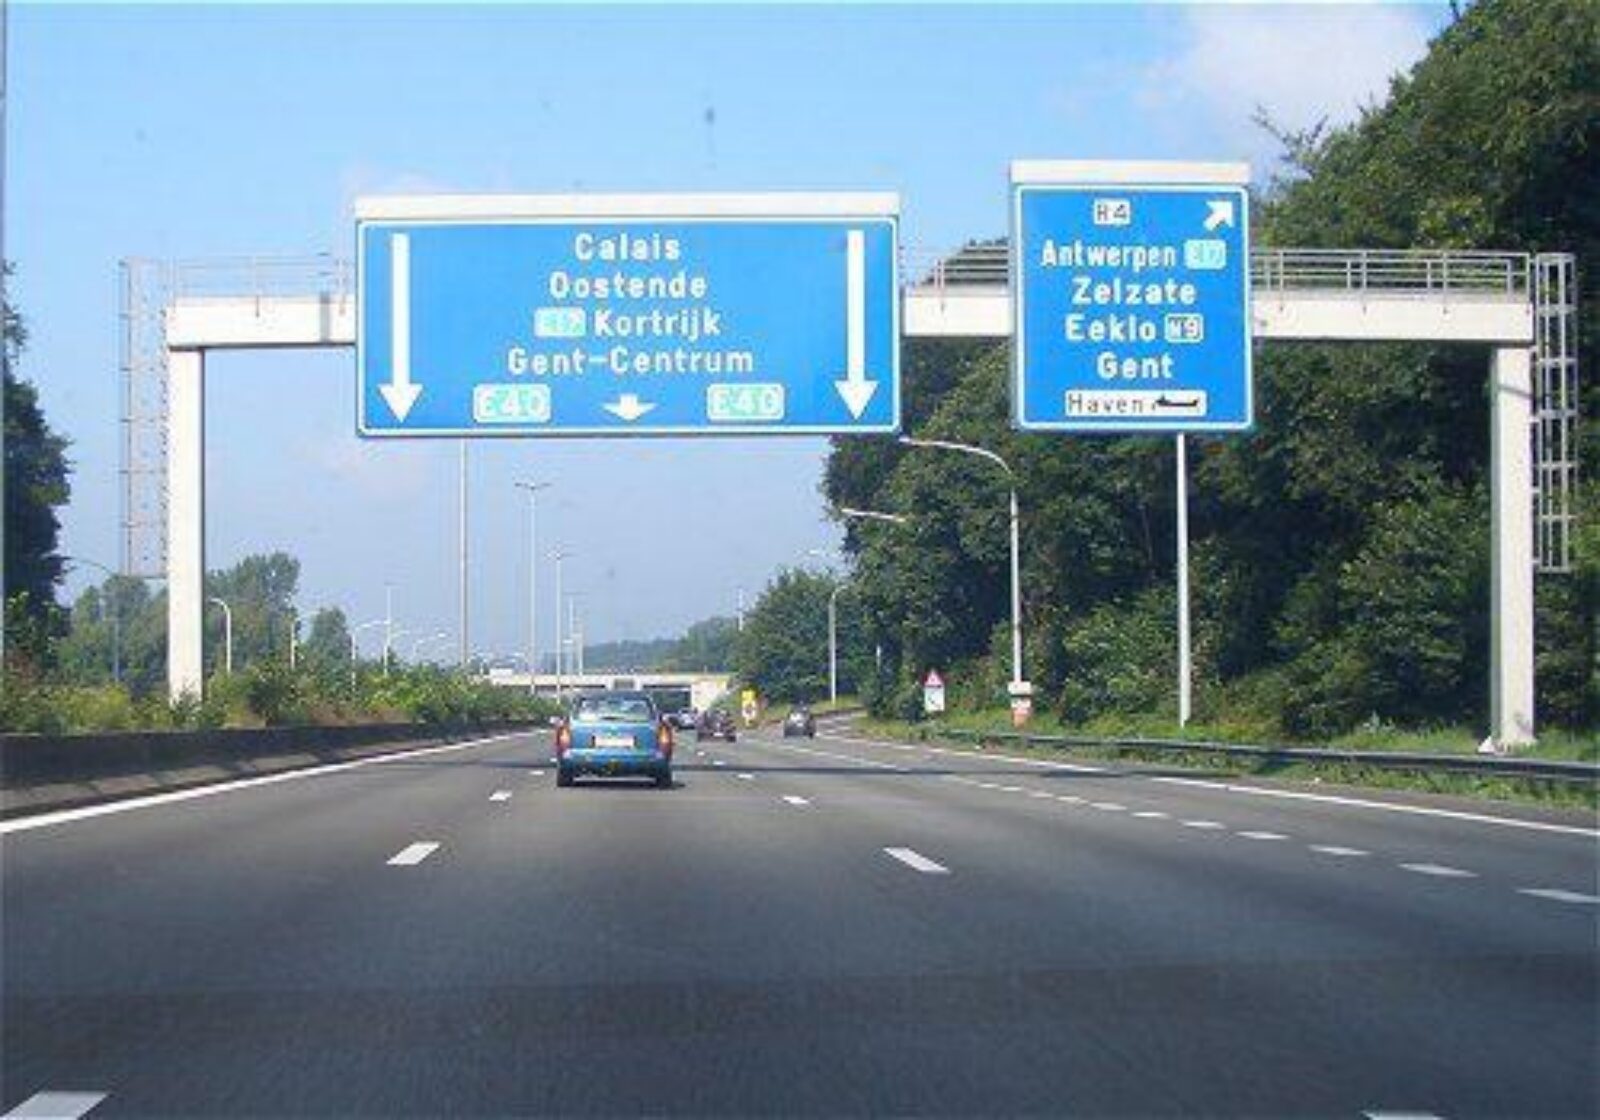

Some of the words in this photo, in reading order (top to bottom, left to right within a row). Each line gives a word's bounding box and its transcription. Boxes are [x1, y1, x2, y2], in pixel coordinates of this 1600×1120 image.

[575, 233, 680, 262] Calais
[1041, 240, 1176, 272] Antwerpen
[550, 272, 706, 300] Oostende
[1071, 278, 1196, 305] Zelzate
[594, 309, 720, 339] Kortrijk
[1065, 314, 1156, 341] Eeklo
[508, 347, 754, 375] Gent-Centrum
[1097, 351, 1174, 379] Gent
[477, 389, 549, 418] E40
[1068, 394, 1144, 414] Haven
